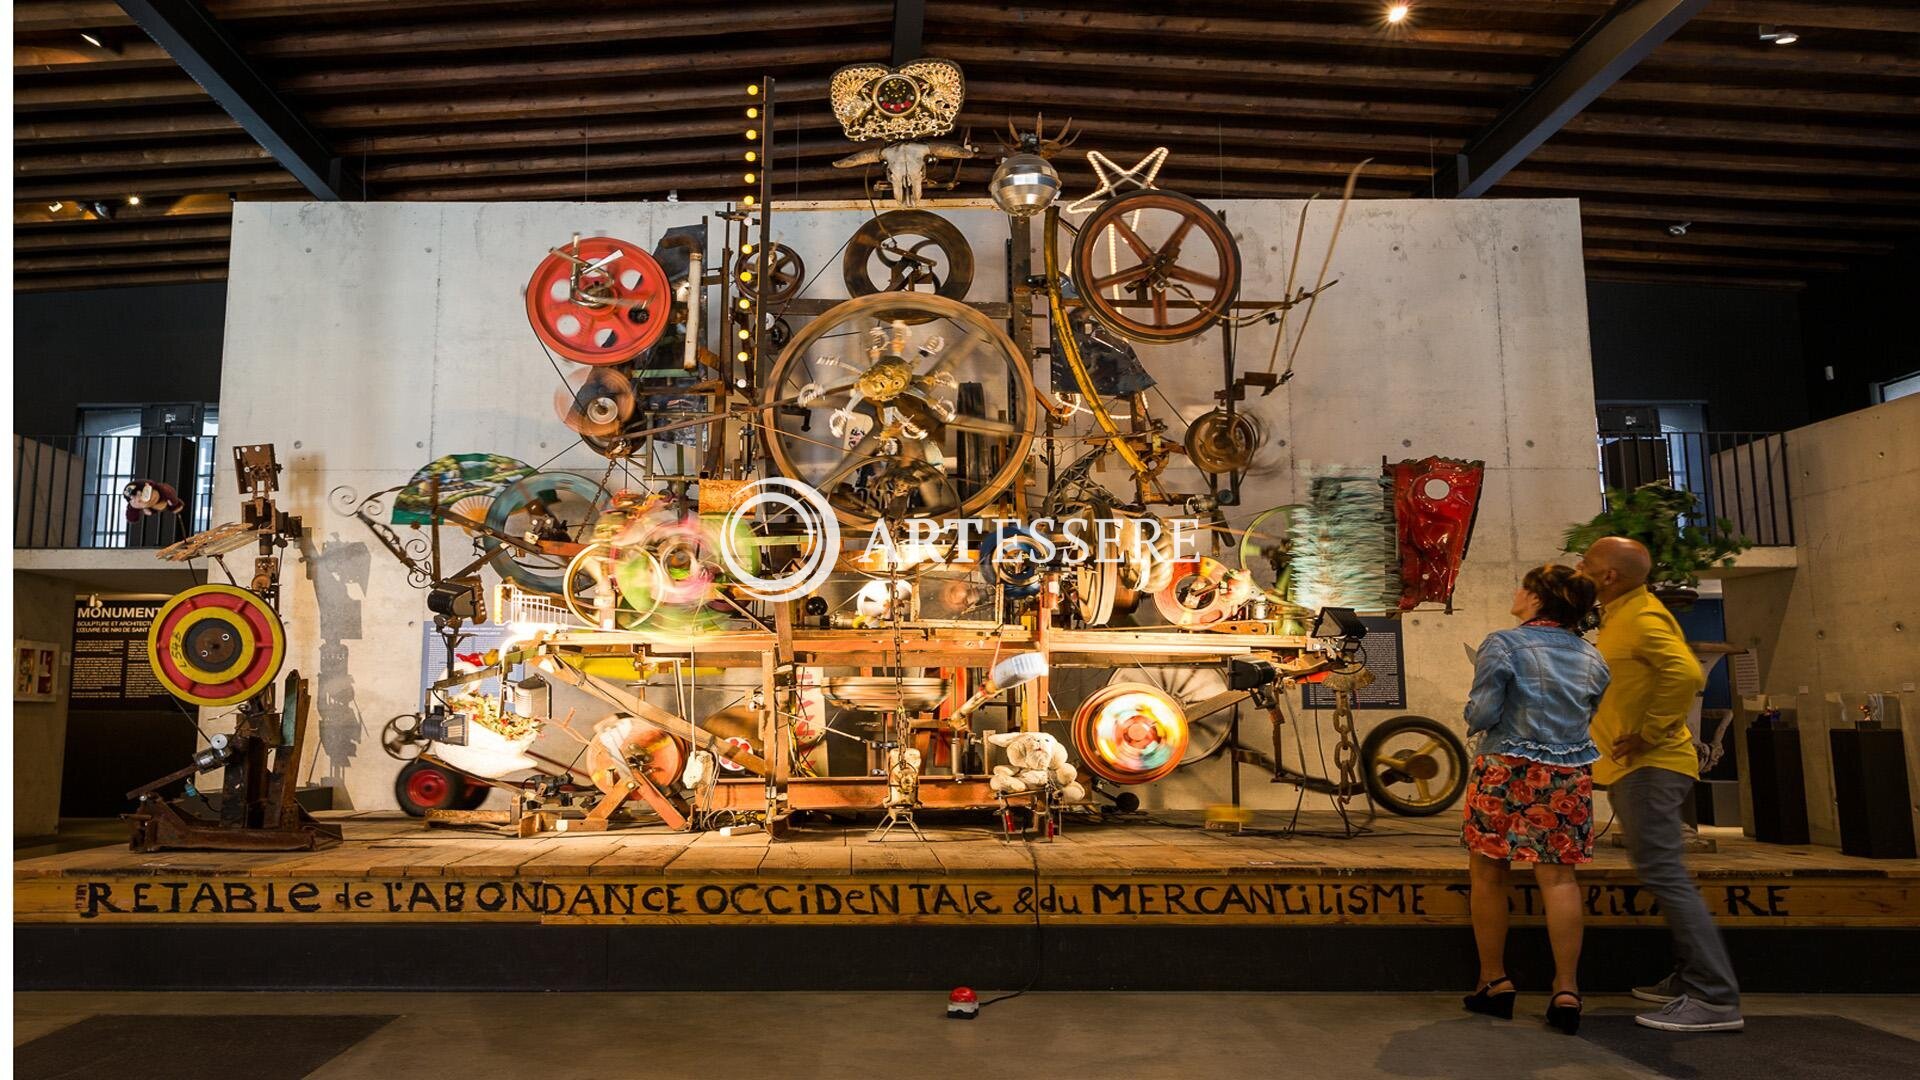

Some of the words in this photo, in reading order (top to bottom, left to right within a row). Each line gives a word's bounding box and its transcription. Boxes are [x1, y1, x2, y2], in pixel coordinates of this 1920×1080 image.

[335, 882, 374, 910] de
[1013, 886, 1036, 913] &
[1039, 884, 1083, 914] du
